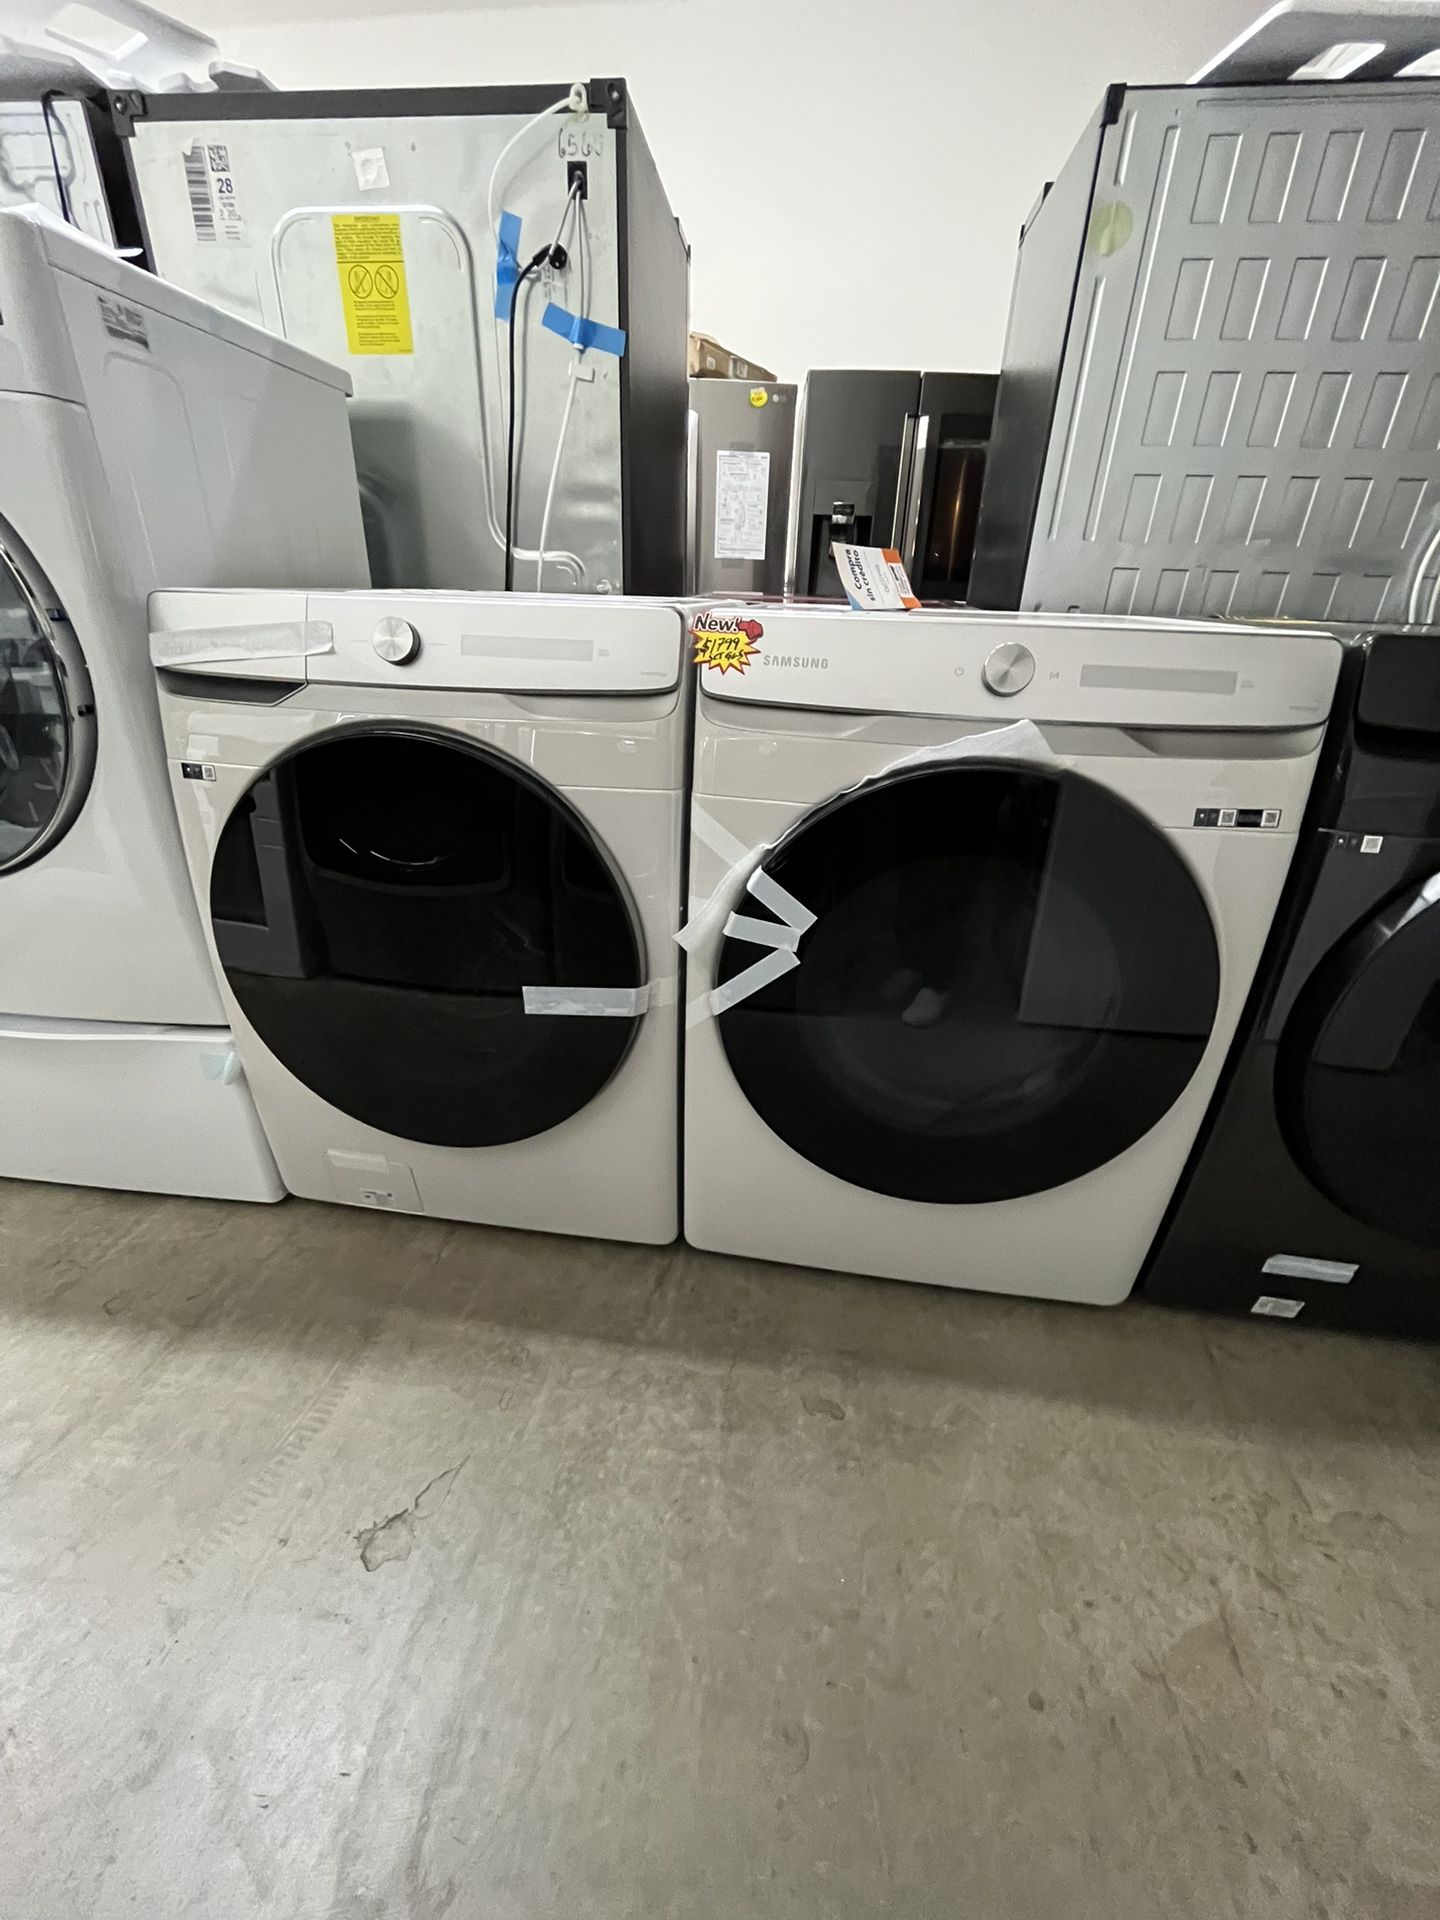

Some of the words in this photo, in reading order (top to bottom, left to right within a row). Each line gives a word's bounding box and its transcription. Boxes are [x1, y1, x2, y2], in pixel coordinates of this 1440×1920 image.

[216, 178, 234, 193] 28
[845, 549, 862, 590] Compra
[866, 587, 876, 601] sin
[694, 613, 742, 632] New!
[700, 637, 740, 657] $1799
[763, 655, 829, 669] SAMSUNG
